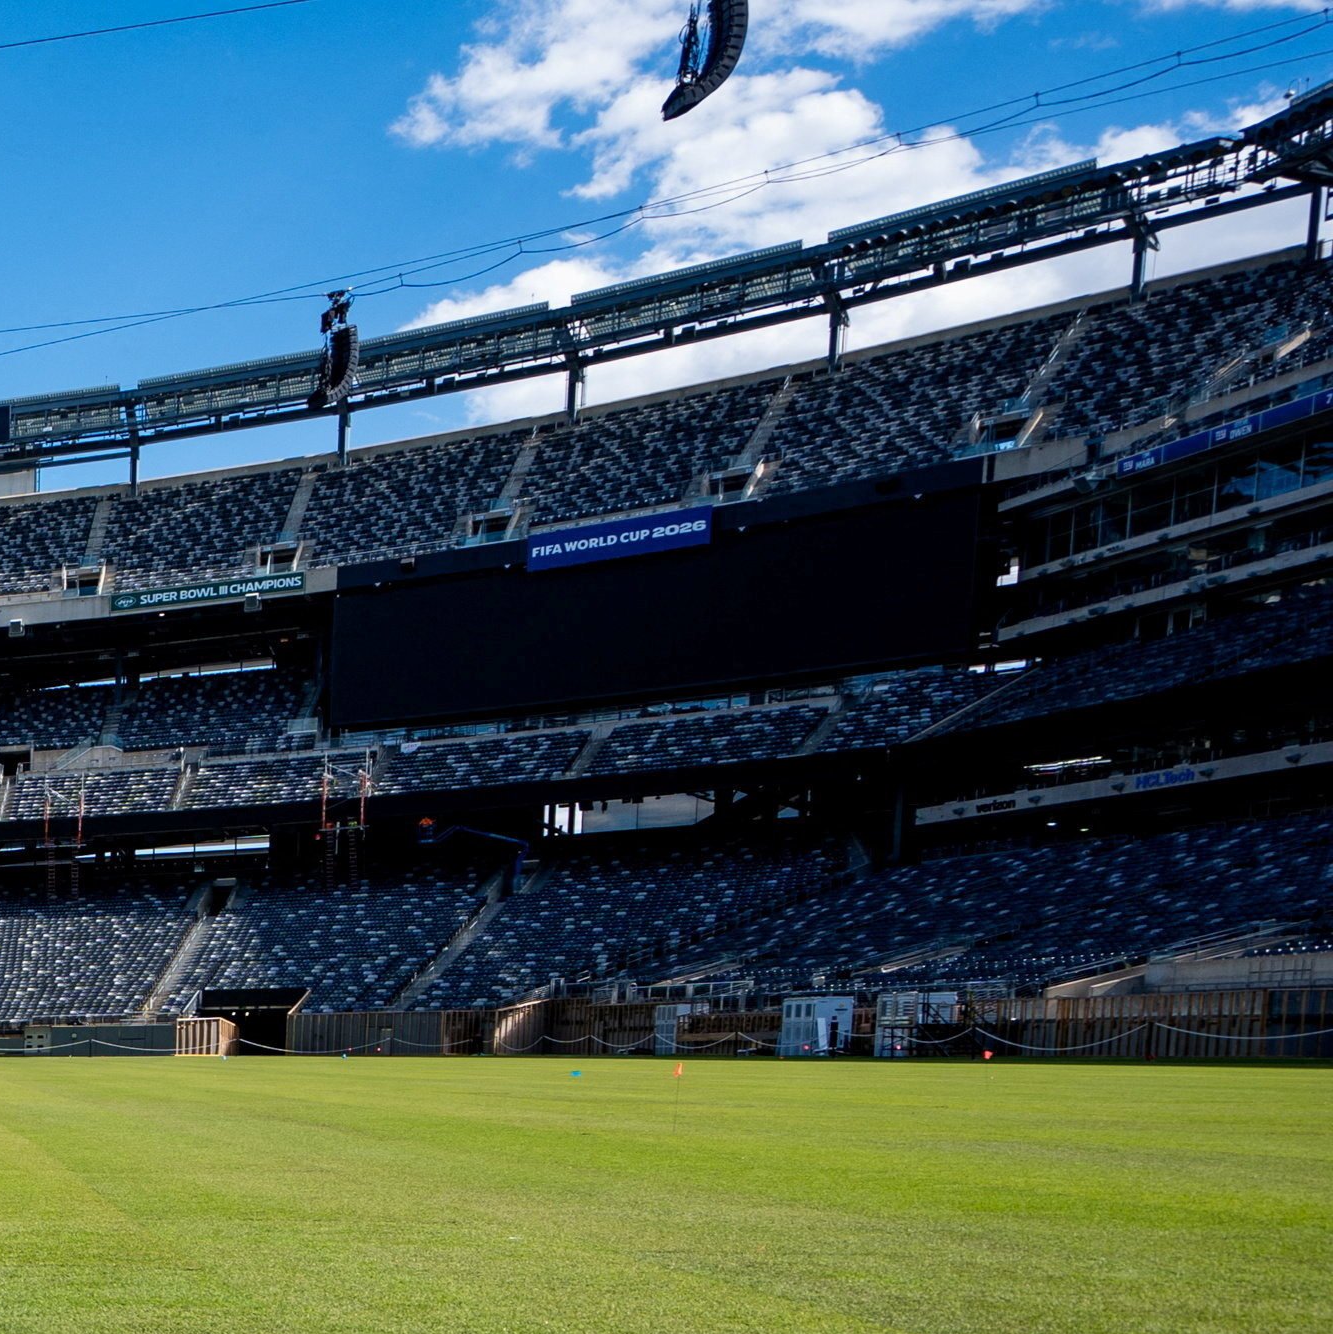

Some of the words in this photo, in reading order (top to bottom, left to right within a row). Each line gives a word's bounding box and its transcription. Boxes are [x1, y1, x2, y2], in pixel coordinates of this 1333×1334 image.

[531, 543, 562, 558] FIFA
[564, 534, 618, 552] WORLD
[619, 529, 650, 543] CUP
[652, 520, 707, 539] 2026
[140, 591, 178, 605] SUPER
[180, 587, 218, 600] BOWL
[219, 586, 228, 595] III
[229, 575, 302, 593] CHAMPIONS
[1134, 767, 1195, 790] HCLTech
[976, 798, 1016, 814] verizon
